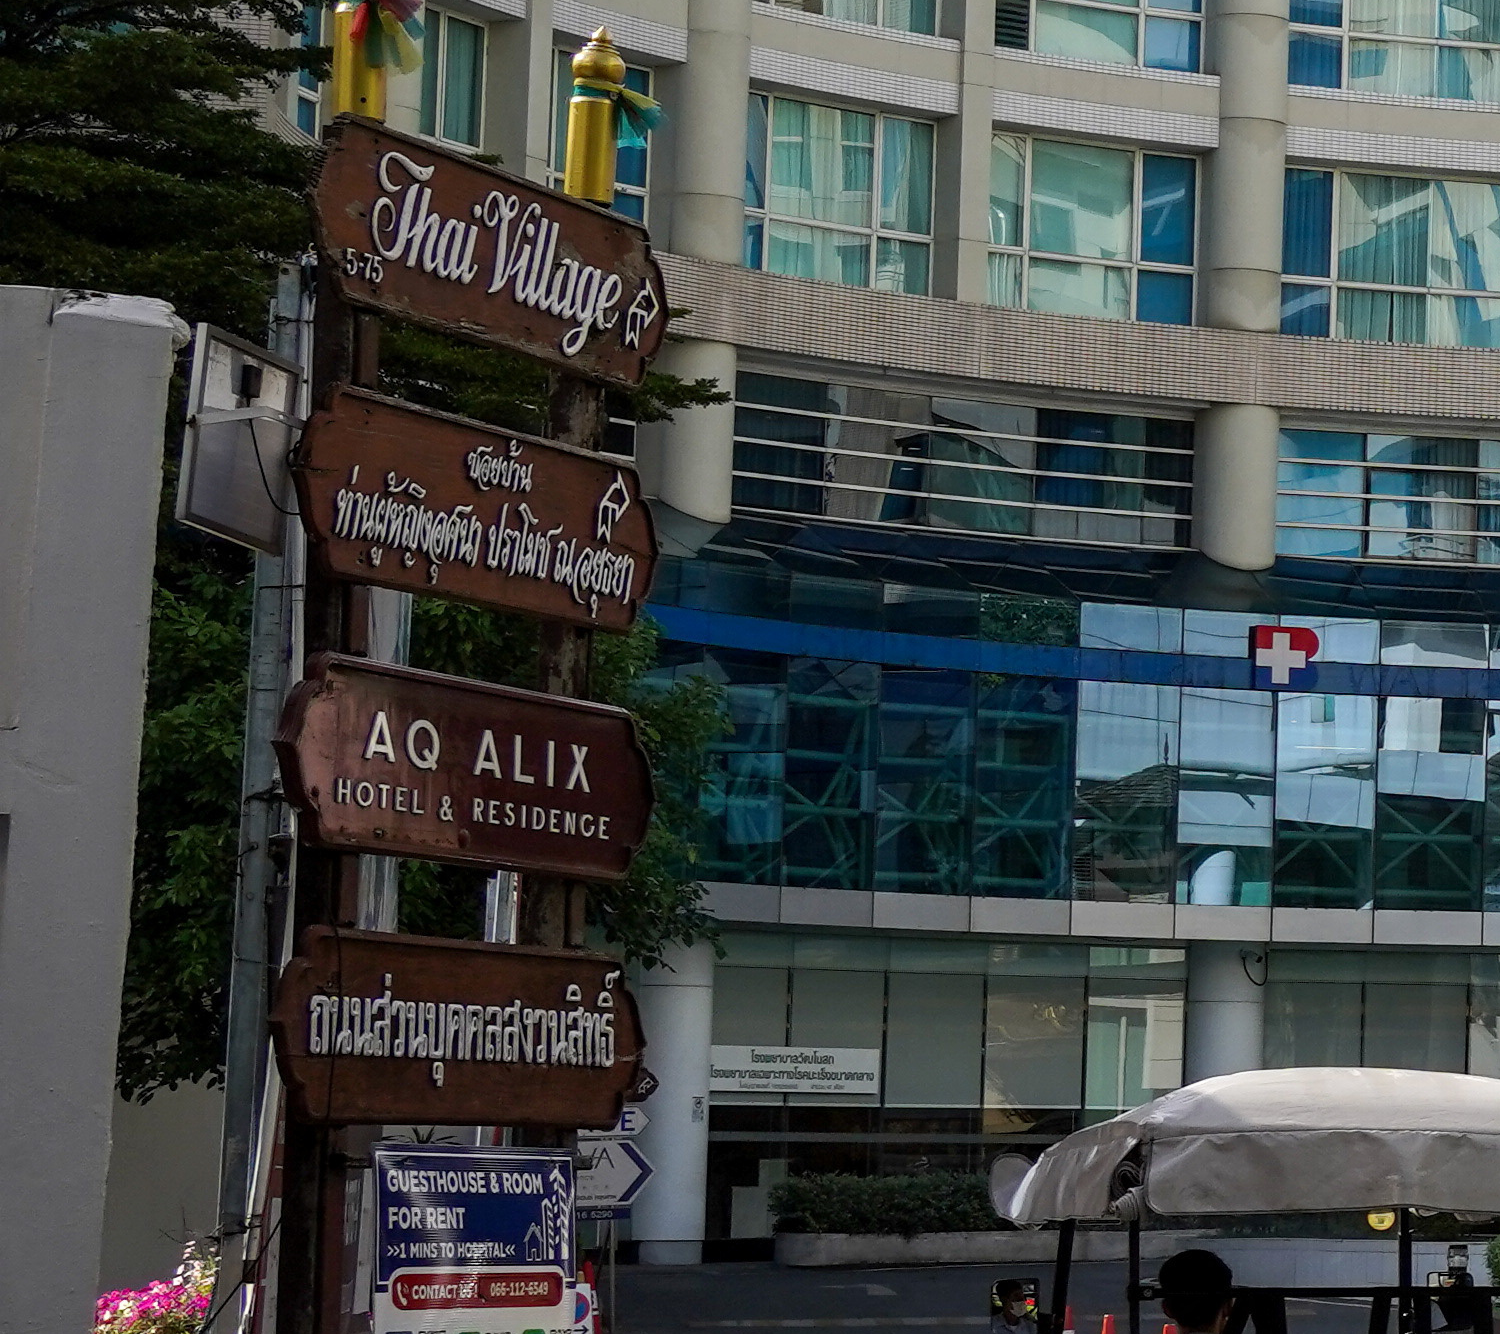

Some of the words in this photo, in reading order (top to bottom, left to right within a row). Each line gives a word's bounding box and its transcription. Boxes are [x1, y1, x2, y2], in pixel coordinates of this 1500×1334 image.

[345, 247, 384, 283] 5-75
[371, 151, 478, 285] Thai
[483, 190, 623, 357] Village
[467, 439, 534, 493] ซอยบ้าน
[363, 710, 441, 772] AQ
[472, 729, 591, 794] ALIX
[336, 777, 425, 816] HOTEL
[438, 795, 454, 823] &
[309, 969, 621, 1088] ถนนส่วนบุคคลสงวนสิทธิ์
[387, 1169, 487, 1193] GUESTHOUSE
[490, 1172, 500, 1193] &
[503, 1173, 544, 1195] ROOM
[388, 1206, 421, 1230] FOR
[426, 1207, 466, 1230] RENT
[410, 1243, 437, 1258] MINS
[440, 1244, 456, 1258] TO
[412, 1284, 457, 1299] CONTACT
